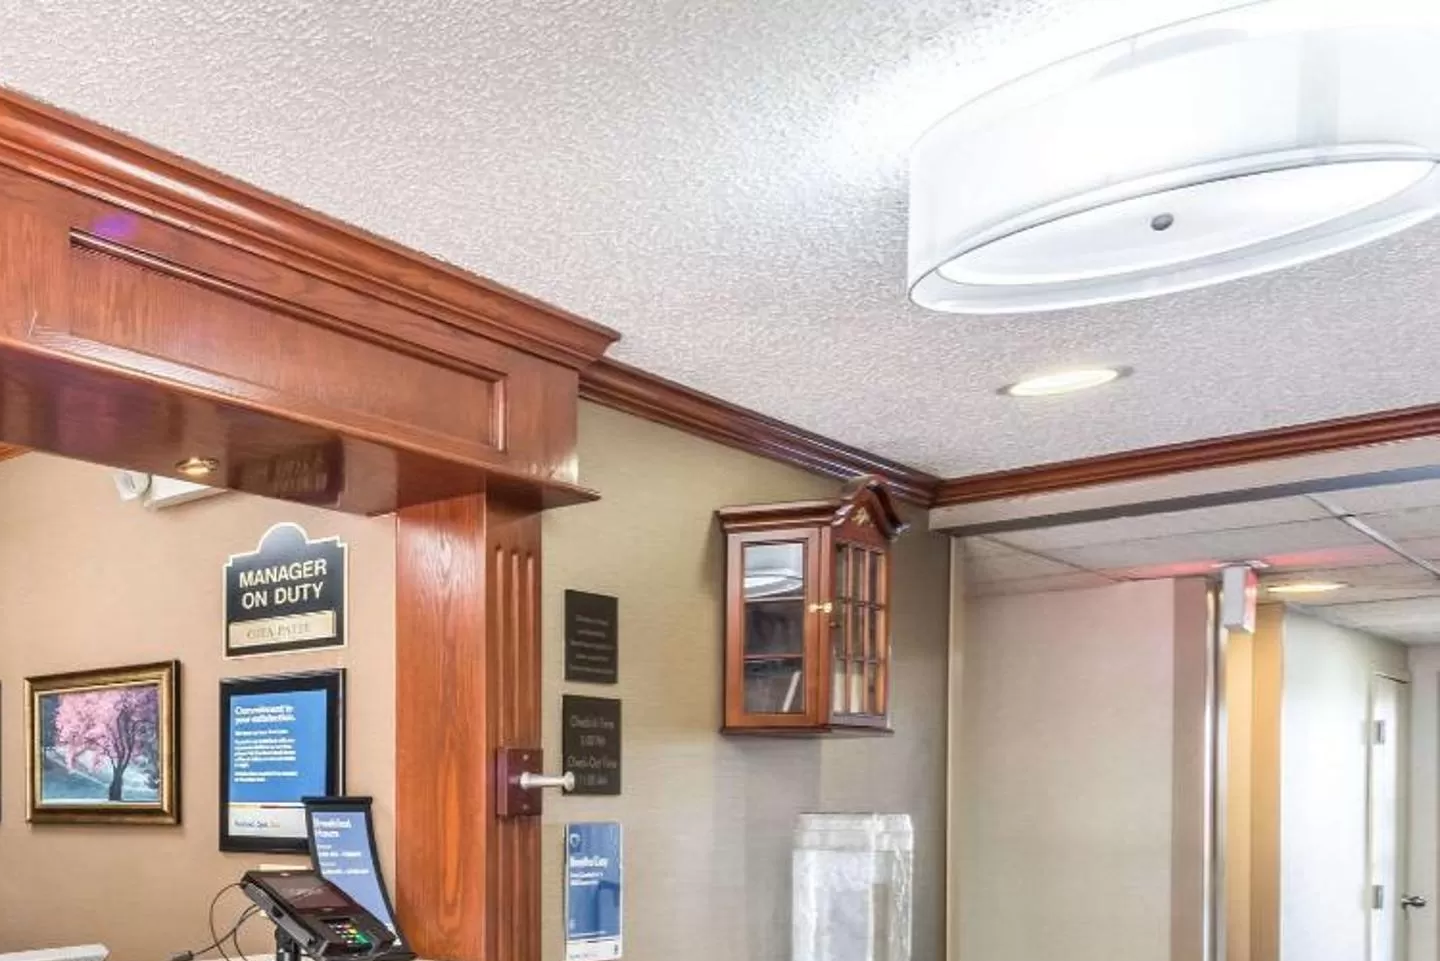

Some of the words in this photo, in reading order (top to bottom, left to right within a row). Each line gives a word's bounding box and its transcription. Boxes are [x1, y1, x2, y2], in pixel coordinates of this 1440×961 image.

[239, 558, 327, 588] MANAGER
[242, 590, 268, 610] ON
[274, 582, 324, 605] DUTY
